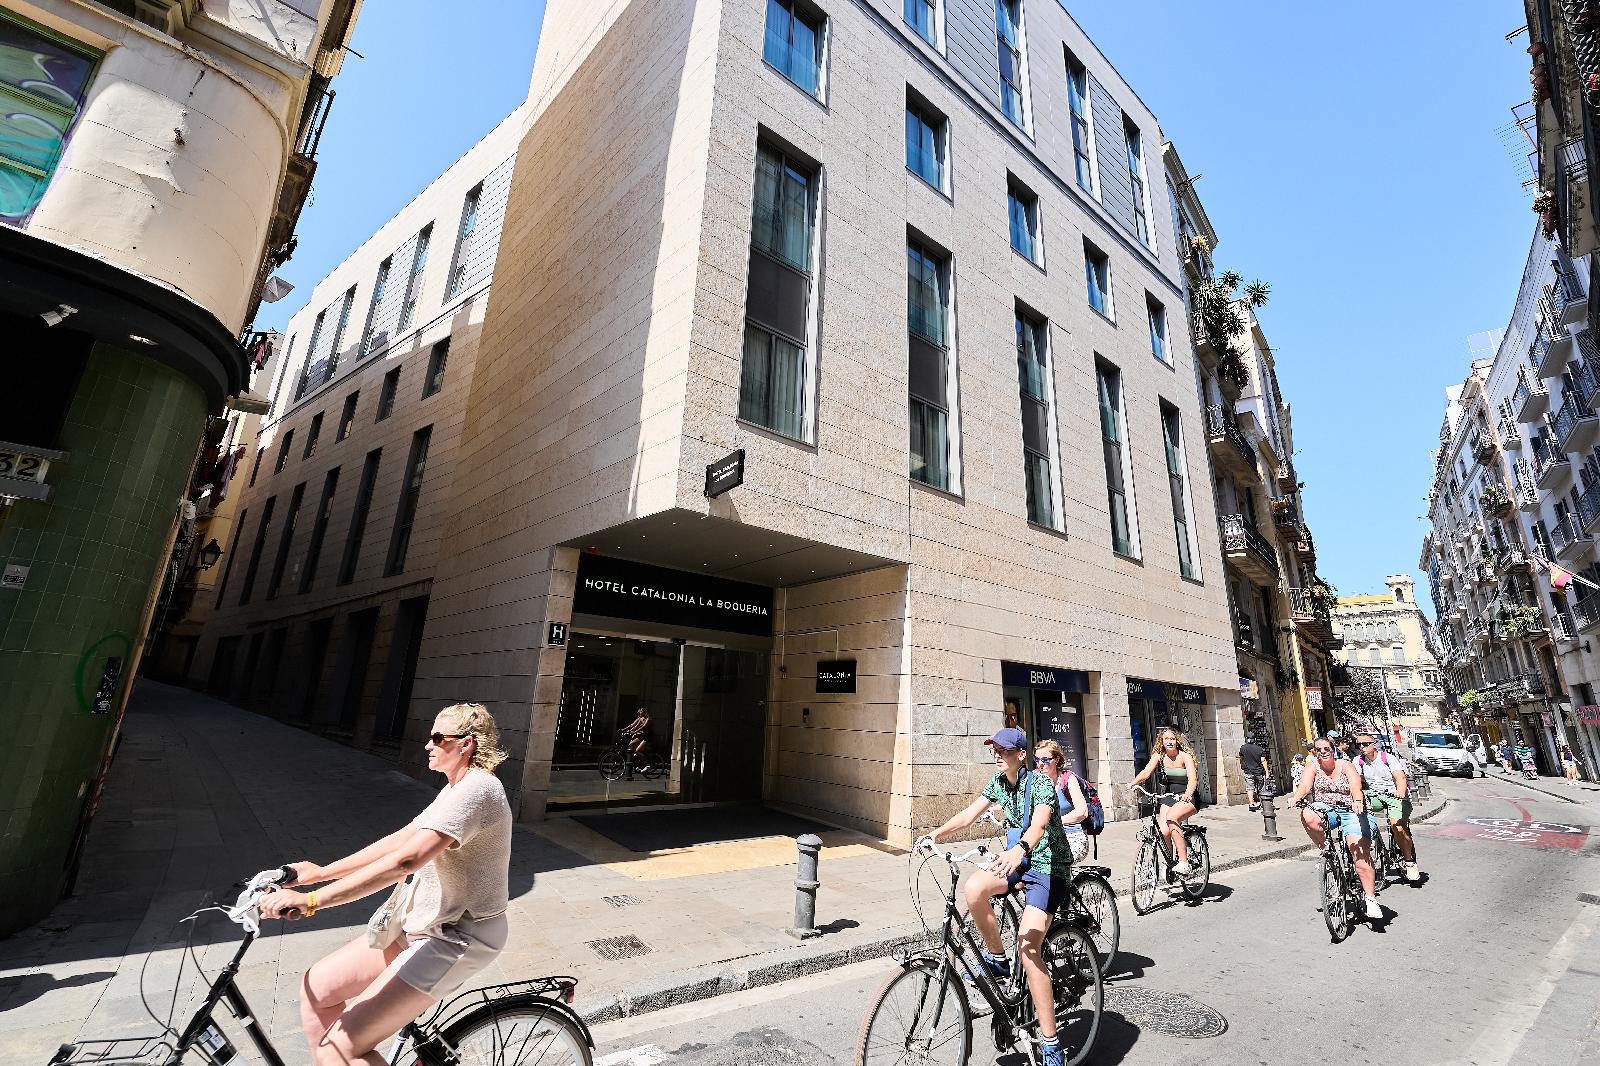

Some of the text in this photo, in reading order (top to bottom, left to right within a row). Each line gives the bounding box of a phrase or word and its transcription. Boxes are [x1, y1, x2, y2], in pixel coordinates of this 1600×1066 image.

[585, 578, 768, 616] HOTEL CATALONIA LA BOQUERIA
[552, 625, 564, 639] H
[1030, 670, 1056, 685] BBVA
